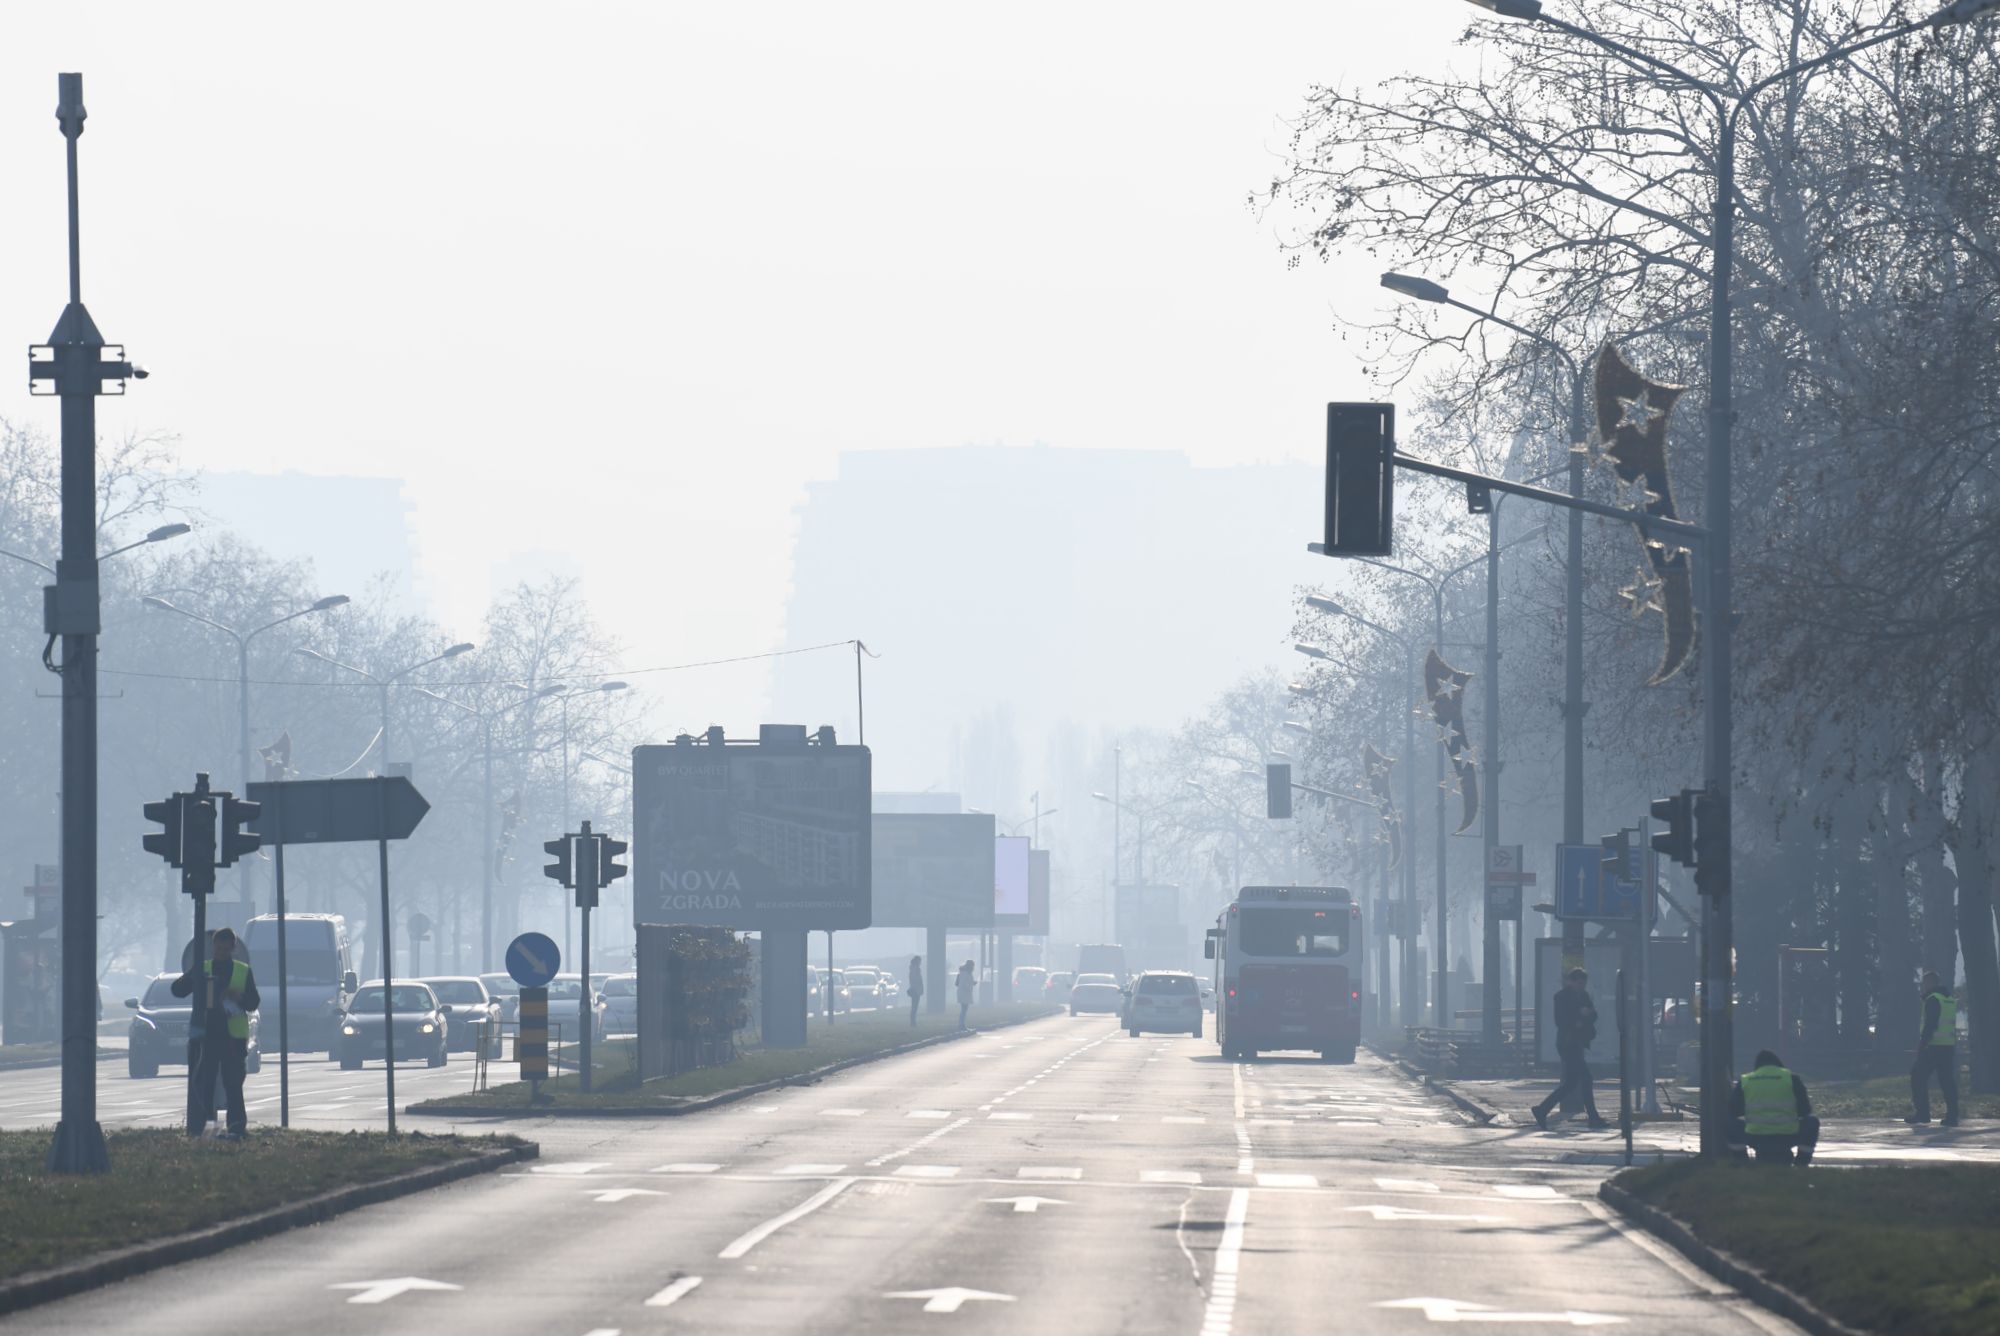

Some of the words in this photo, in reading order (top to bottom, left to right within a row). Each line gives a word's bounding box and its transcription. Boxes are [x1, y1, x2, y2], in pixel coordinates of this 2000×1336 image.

[658, 765, 677, 776] BW
[659, 870, 741, 891] NOVA
[660, 894, 742, 910] ZGRADA
